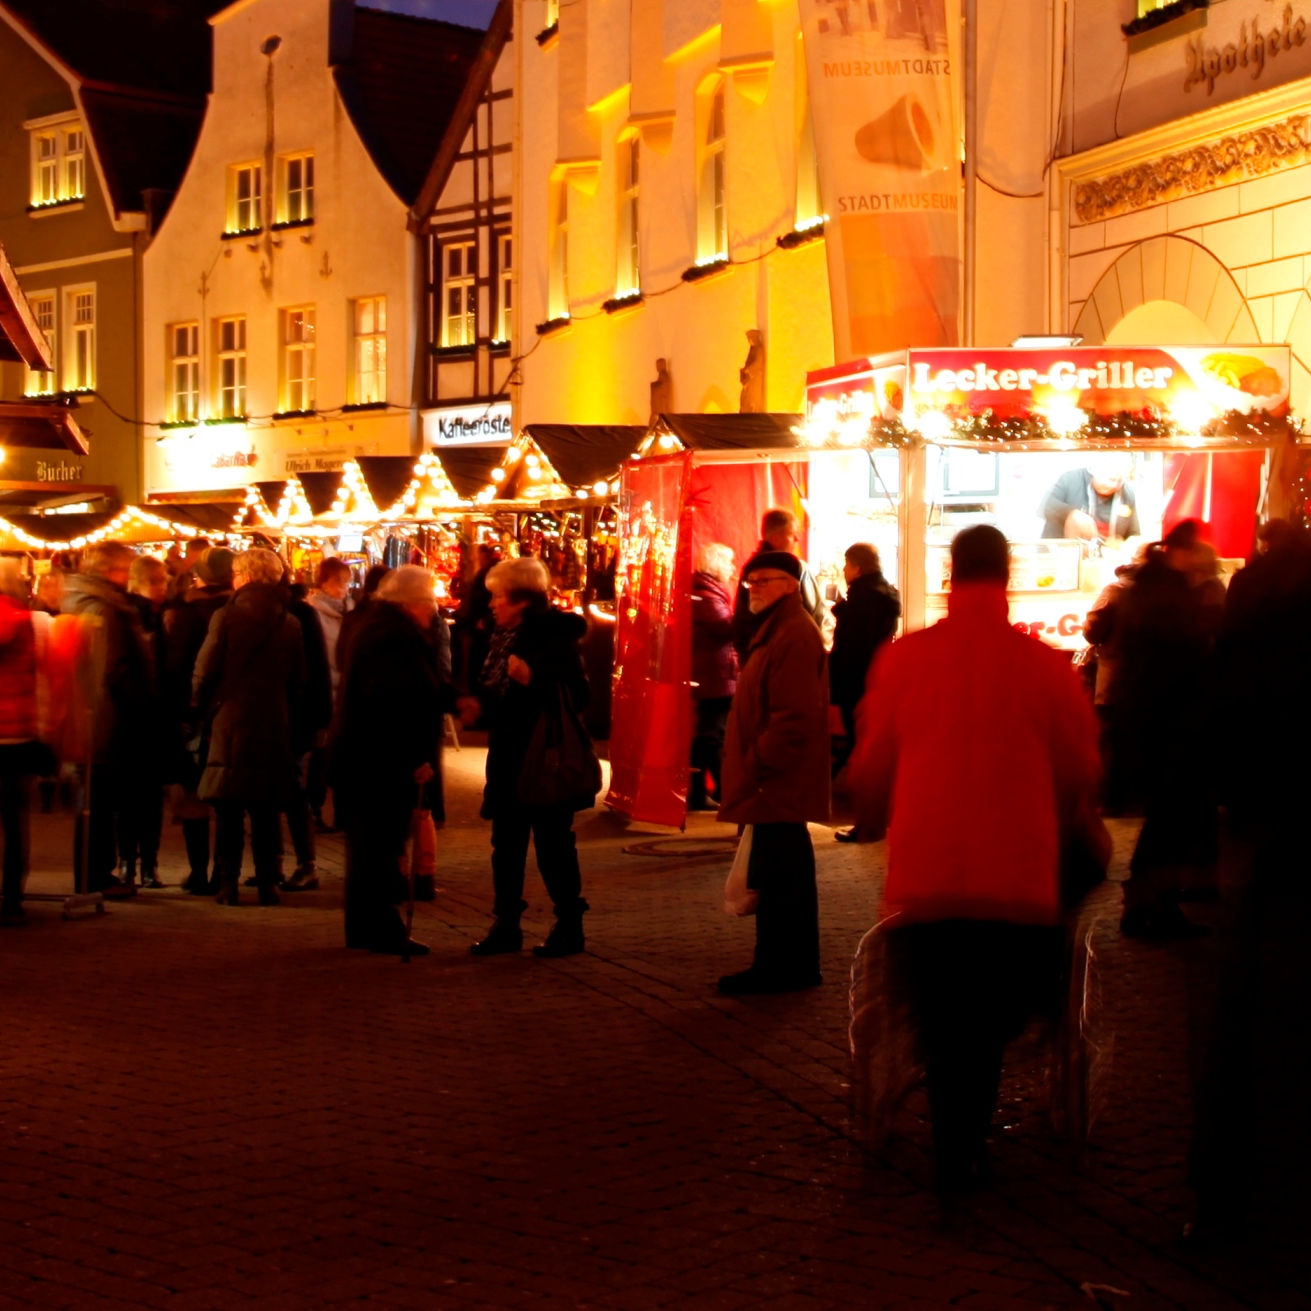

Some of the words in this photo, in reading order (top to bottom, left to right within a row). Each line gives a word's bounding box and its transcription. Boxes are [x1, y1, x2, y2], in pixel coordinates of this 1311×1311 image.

[1183, 2, 1307, 96] Apotheke
[912, 361, 1173, 392] Lecker-Griller
[36, 460, 82, 482] Bücher
